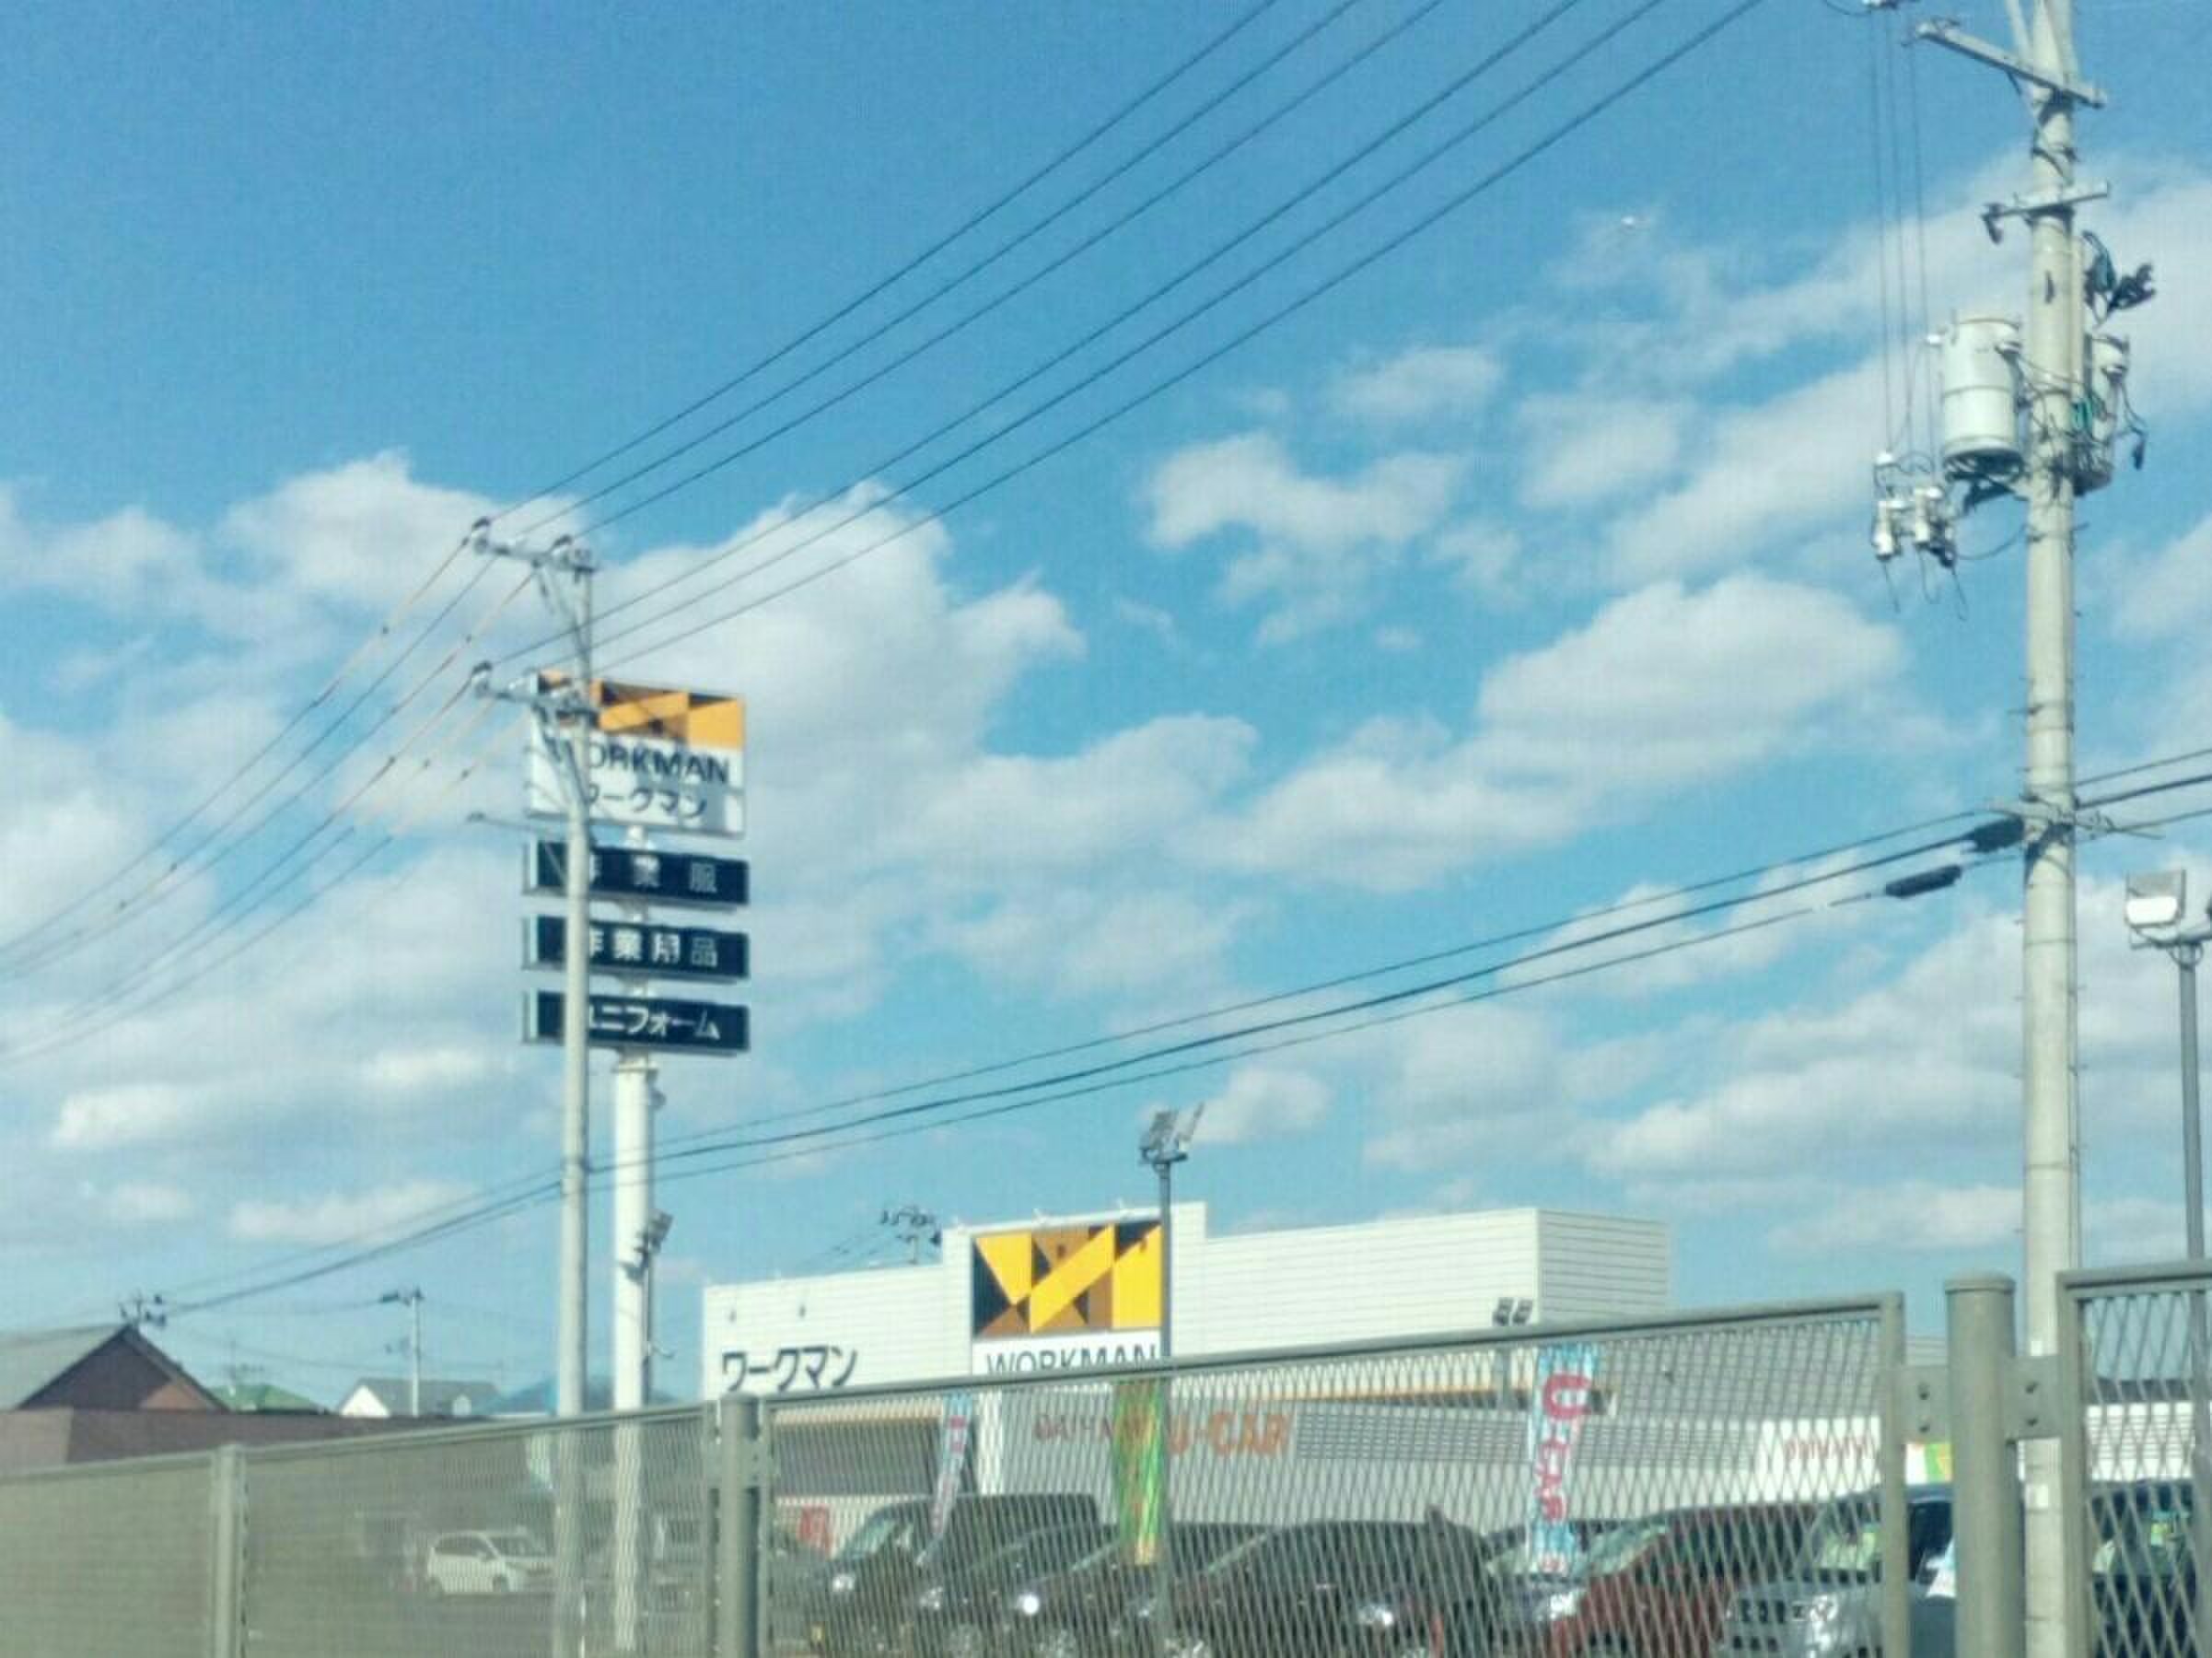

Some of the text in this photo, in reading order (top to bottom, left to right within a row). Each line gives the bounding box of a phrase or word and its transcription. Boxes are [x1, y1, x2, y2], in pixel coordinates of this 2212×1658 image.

[589, 741, 729, 782] ORKMAN
[589, 1004, 721, 1040] ニフォーム
[722, 1345, 858, 1393] ワークマン
[986, 1343, 1157, 1373] WORKMAN
